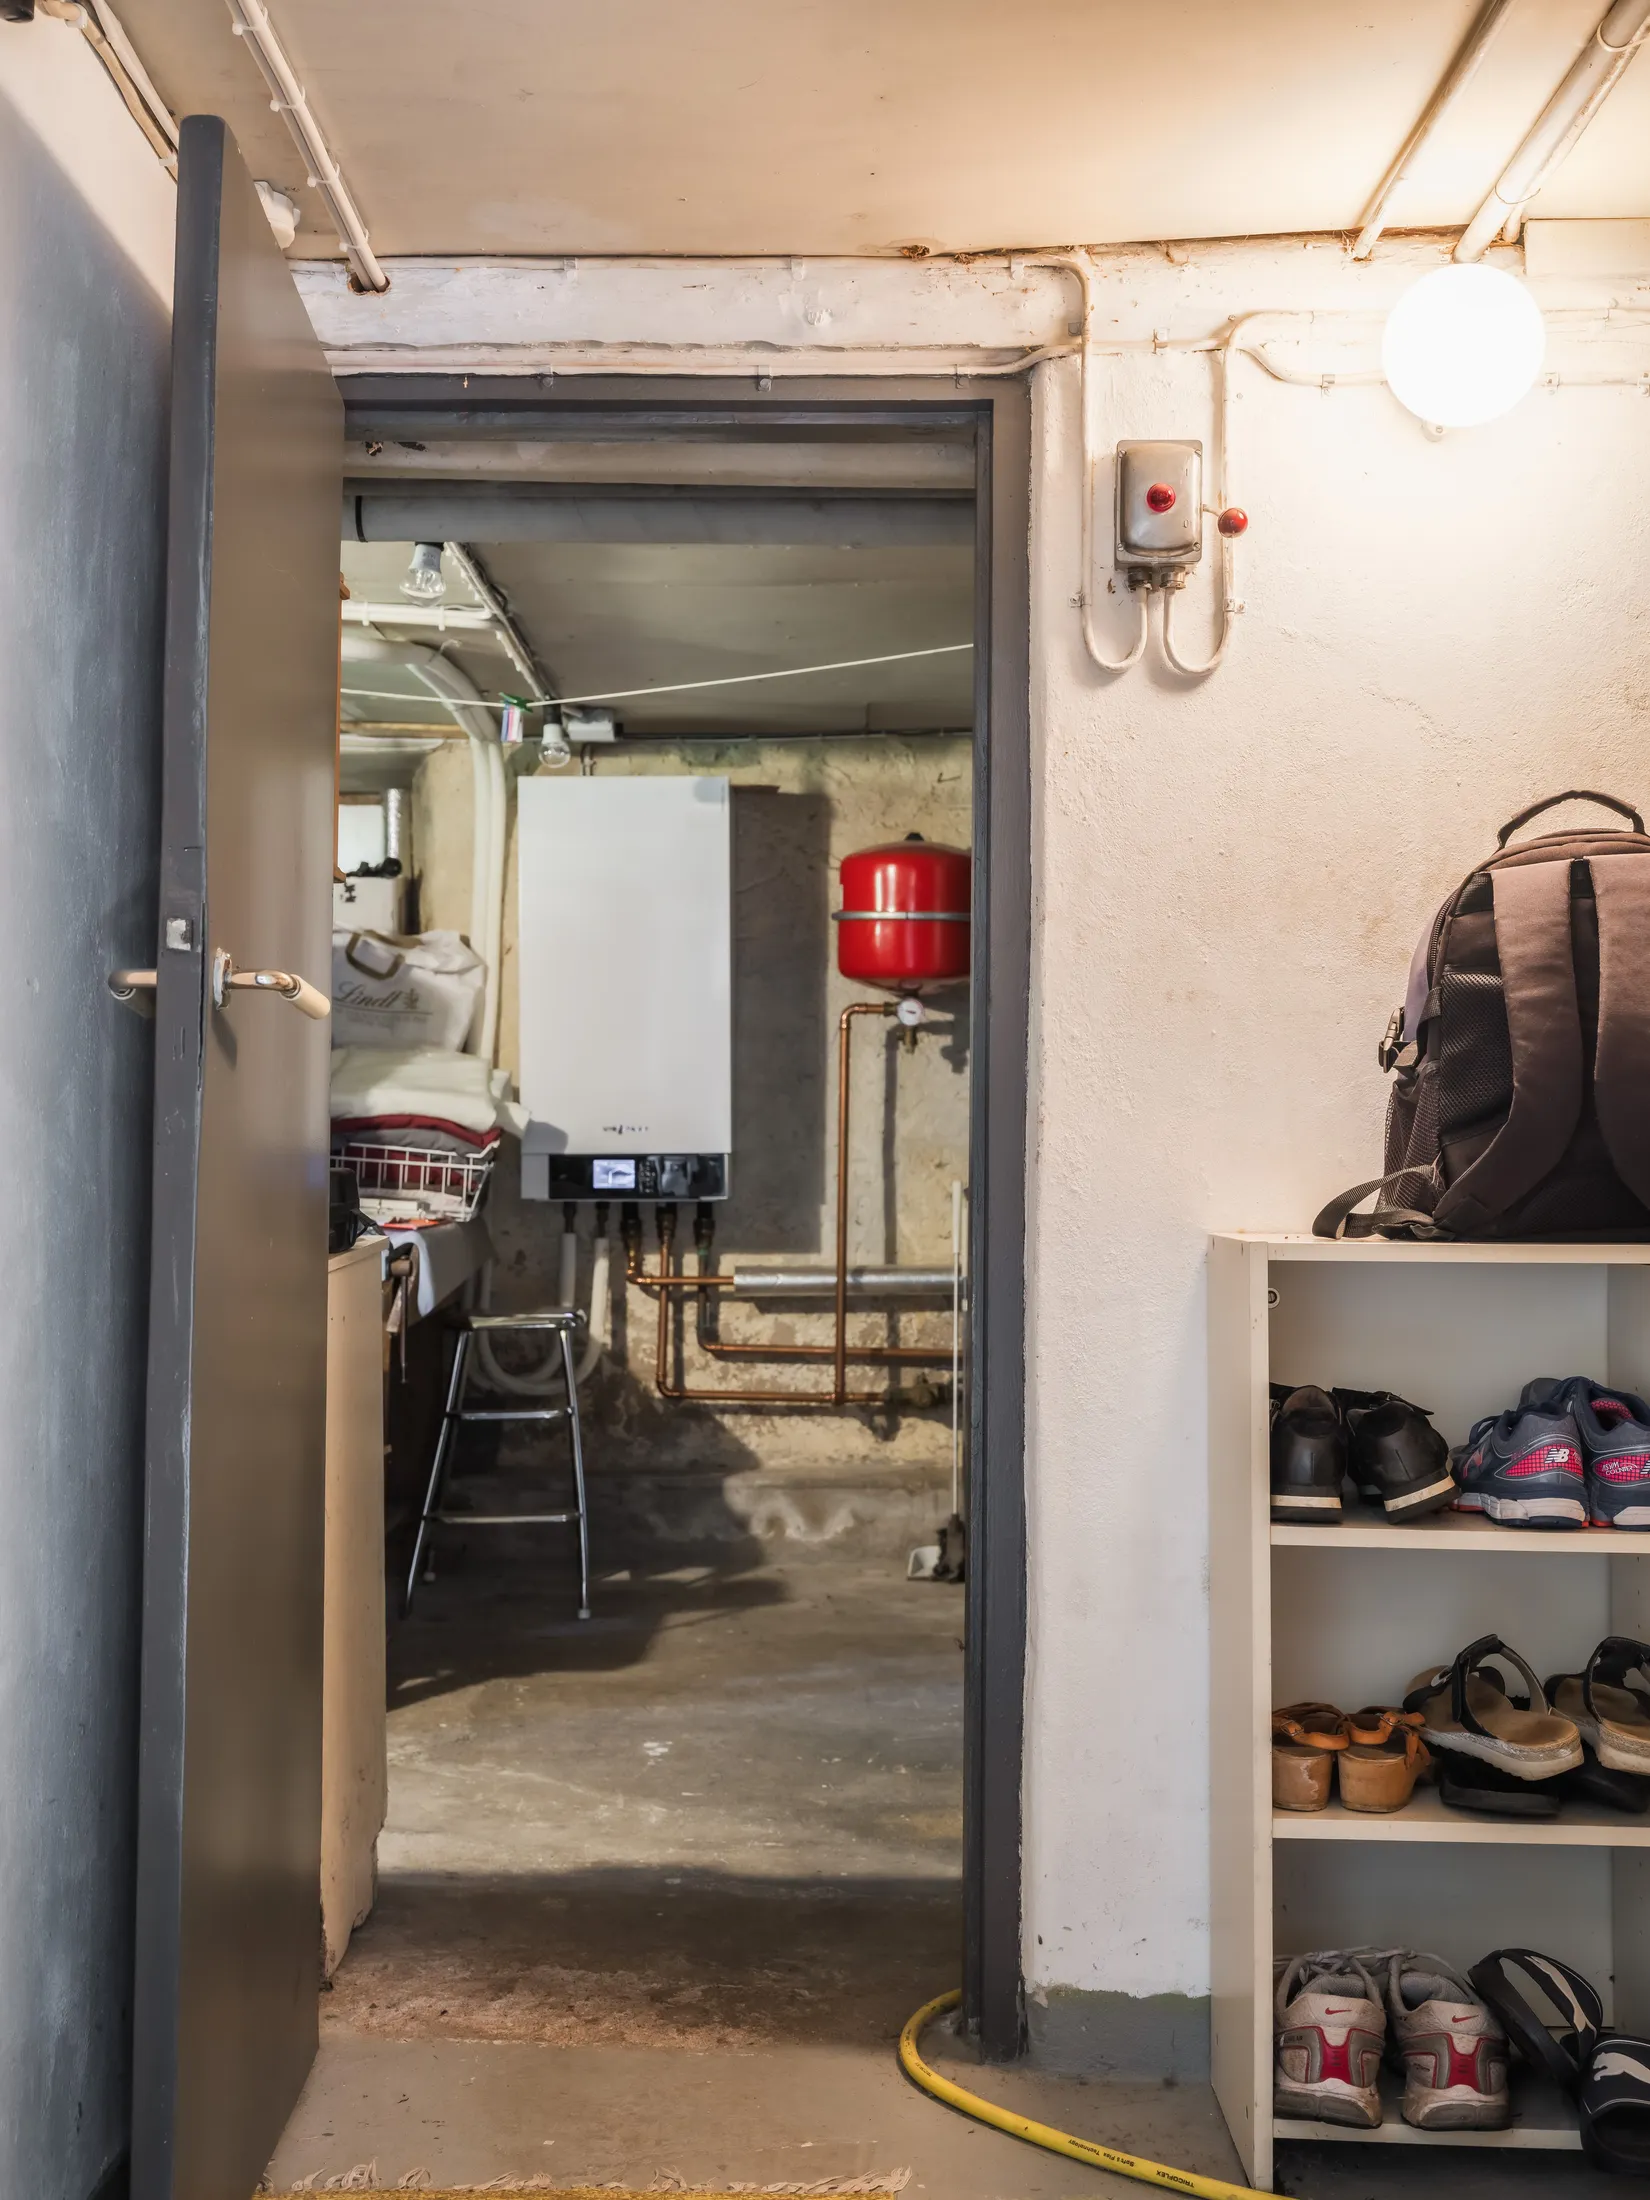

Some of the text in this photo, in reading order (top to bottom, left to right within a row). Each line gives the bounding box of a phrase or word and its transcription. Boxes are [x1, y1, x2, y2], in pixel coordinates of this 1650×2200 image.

[1544, 1448, 1570, 1464] NB
[1068, 2138, 1100, 2156] Technology
[1103, 2151, 1116, 2162] Flex
[1121, 2157, 1135, 2168] Soft
[1156, 2169, 1195, 2188] TRICOFLEX
